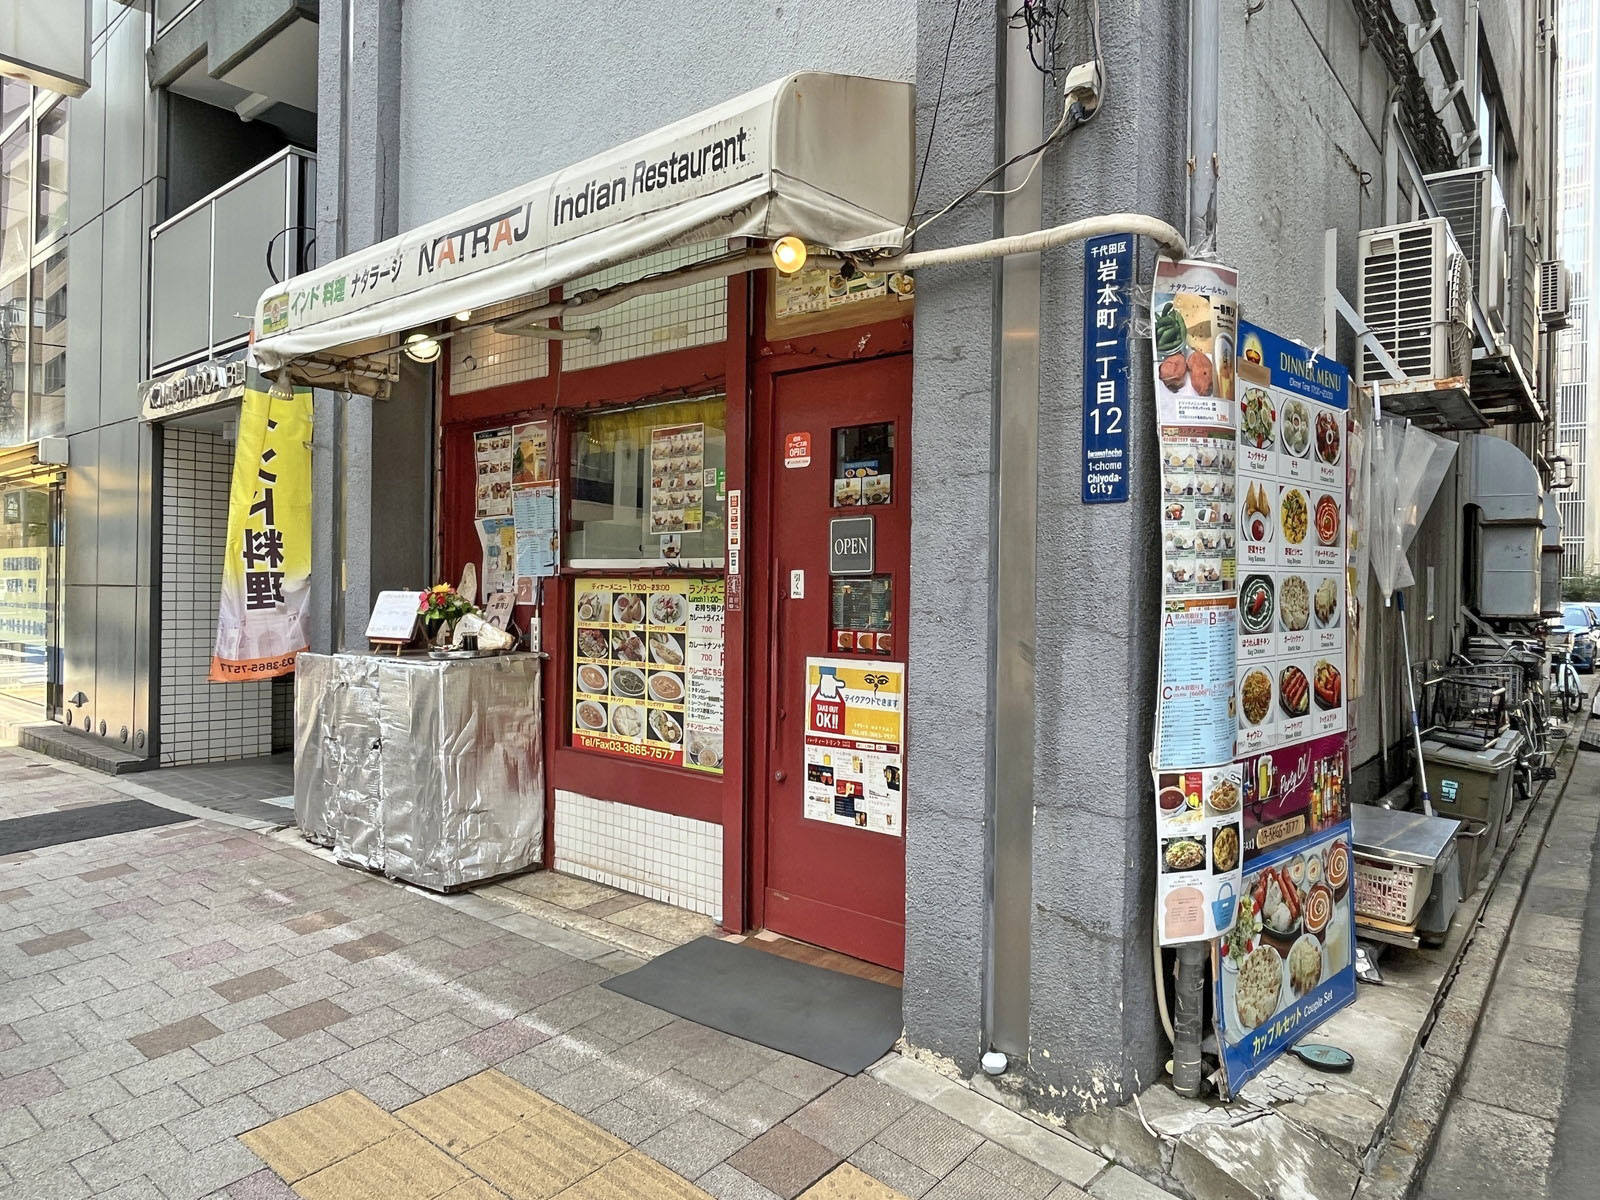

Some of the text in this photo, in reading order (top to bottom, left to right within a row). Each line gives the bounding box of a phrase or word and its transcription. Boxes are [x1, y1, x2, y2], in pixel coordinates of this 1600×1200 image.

[418, 127, 747, 276] NATRAJ Indian Restaurant
[1090, 242, 1127, 258] 千代田区
[351, 254, 403, 298] ナタラージ
[1090, 258, 1123, 435] 岩本町一丁目 12
[1280, 352, 1341, 392] DINNER MENU
[1088, 461, 1122, 471] 1-chome
[1087, 473, 1122, 485] Chiyoda-
[1090, 484, 1113, 495] City
[834, 537, 868, 555] OPEN
[1209, 611, 1217, 626] B
[844, 694, 898, 708] テイクアウトできます
[1162, 686, 1173, 700] C
[816, 712, 838, 729] OK!!
[1303, 989, 1333, 1017] Couple Set
[1252, 1006, 1302, 1057] カップルセット
